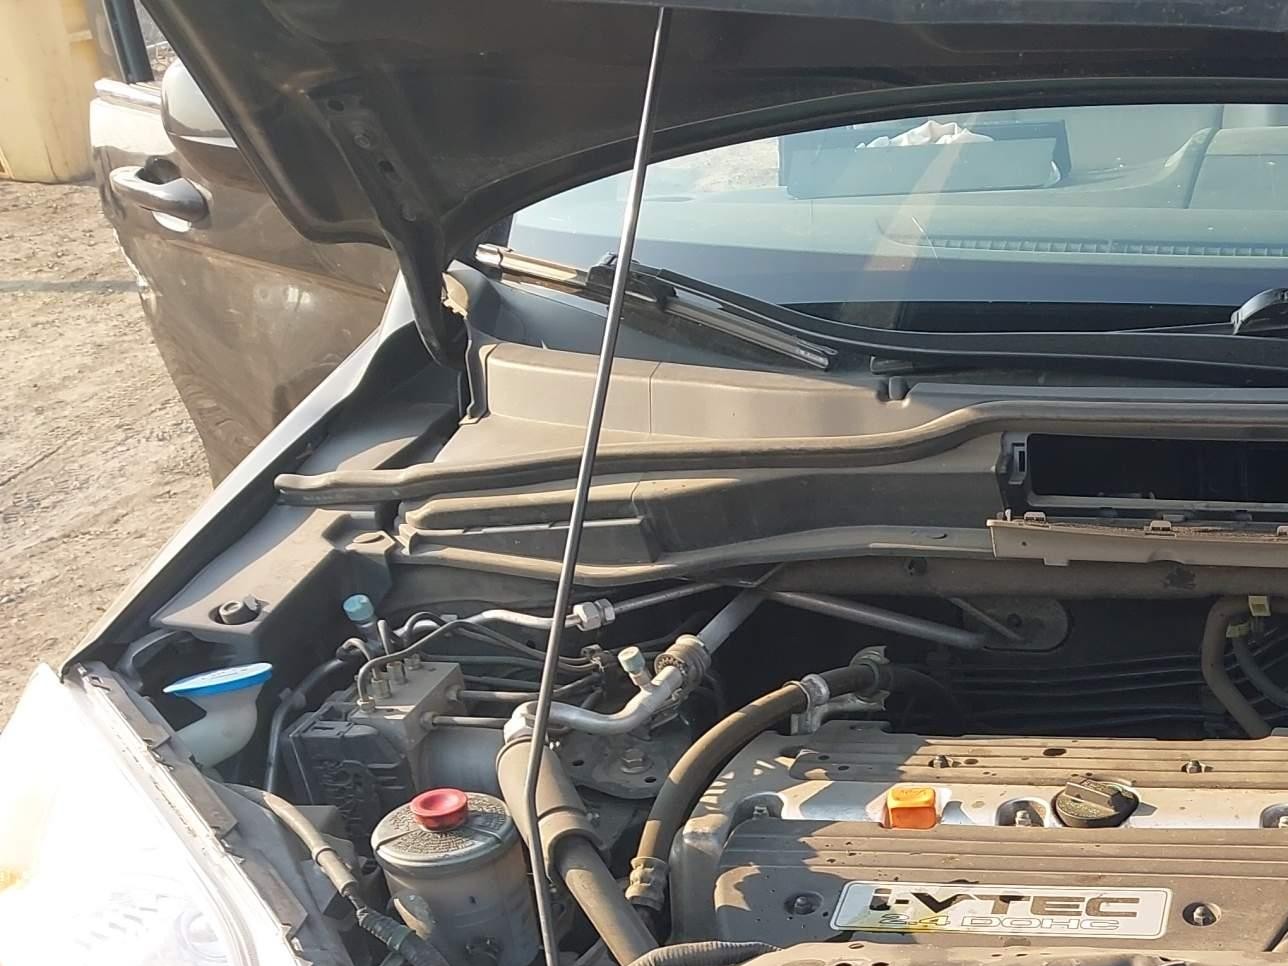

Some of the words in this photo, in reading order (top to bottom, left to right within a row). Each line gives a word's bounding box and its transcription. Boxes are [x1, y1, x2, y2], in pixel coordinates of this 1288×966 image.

[869, 887, 1141, 918] i-VTEC
[878, 913, 951, 927] 2.4
[960, 916, 1120, 931] DOHC
